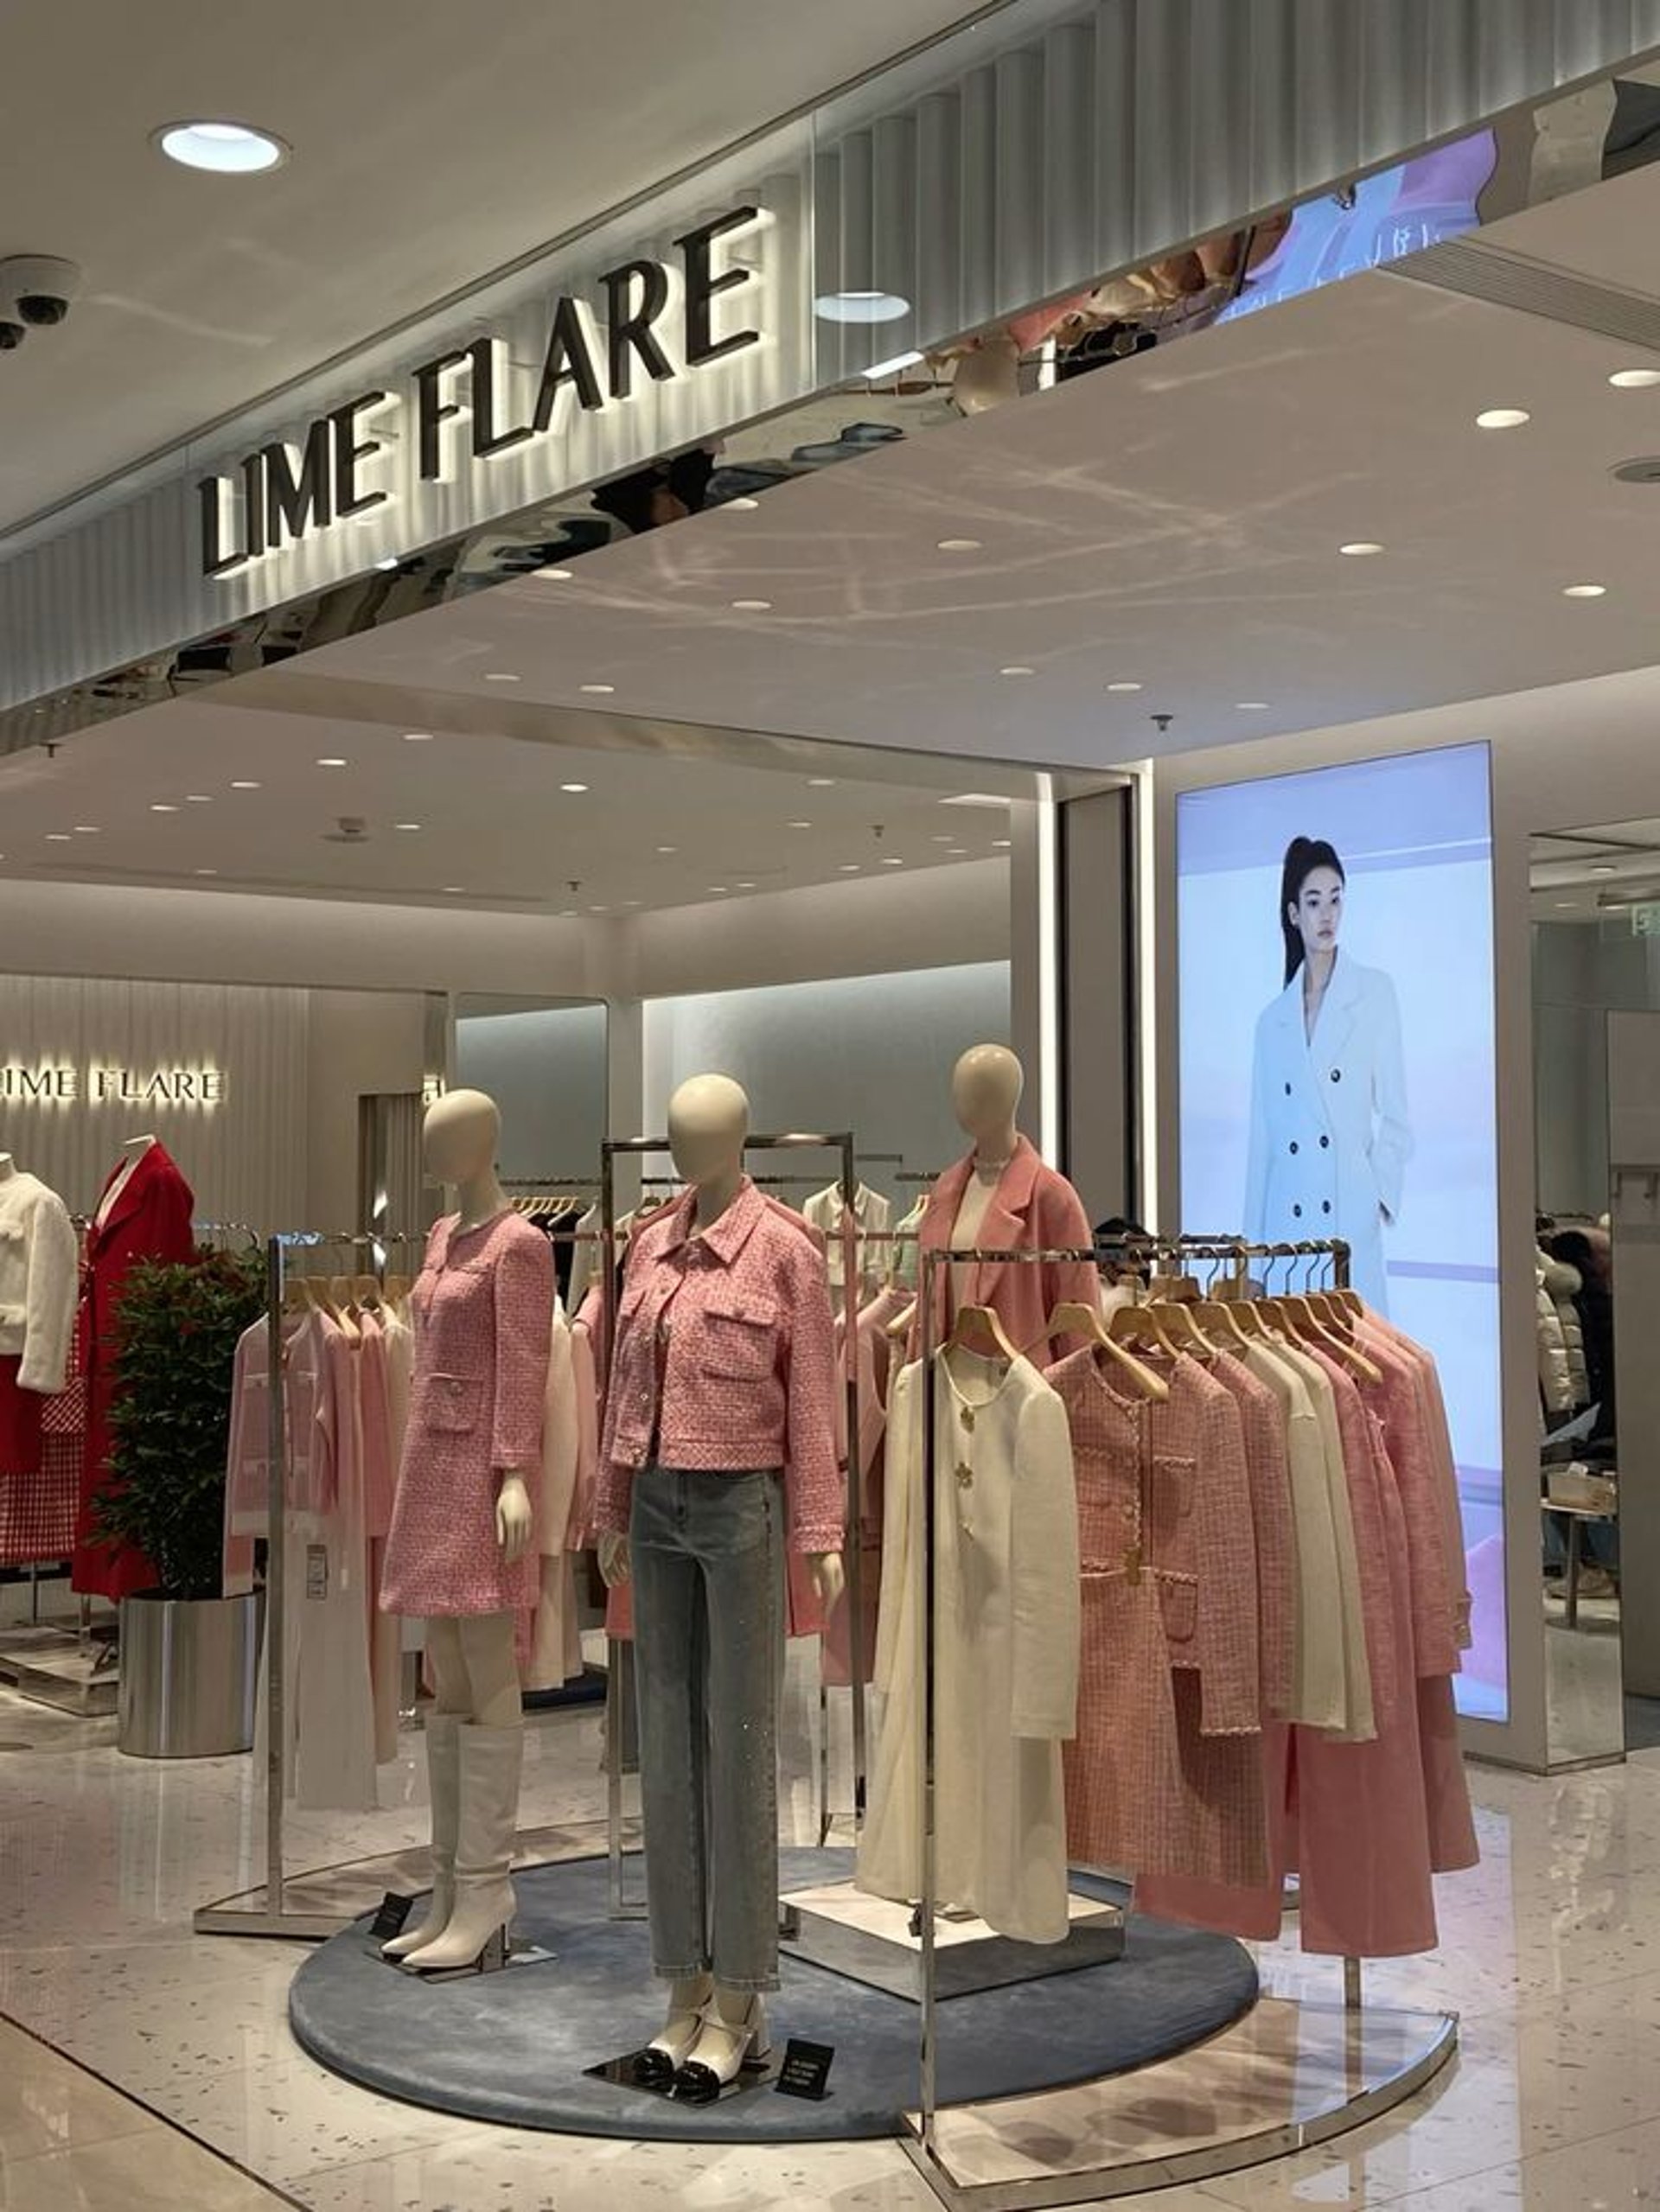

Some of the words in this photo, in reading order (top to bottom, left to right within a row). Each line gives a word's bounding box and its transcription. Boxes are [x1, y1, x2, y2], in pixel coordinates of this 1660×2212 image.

[198, 391, 386, 575] LIME
[412, 206, 760, 481] FLARE
[0, 1068, 76, 1097] IME
[97, 1069, 223, 1100] FLARE
